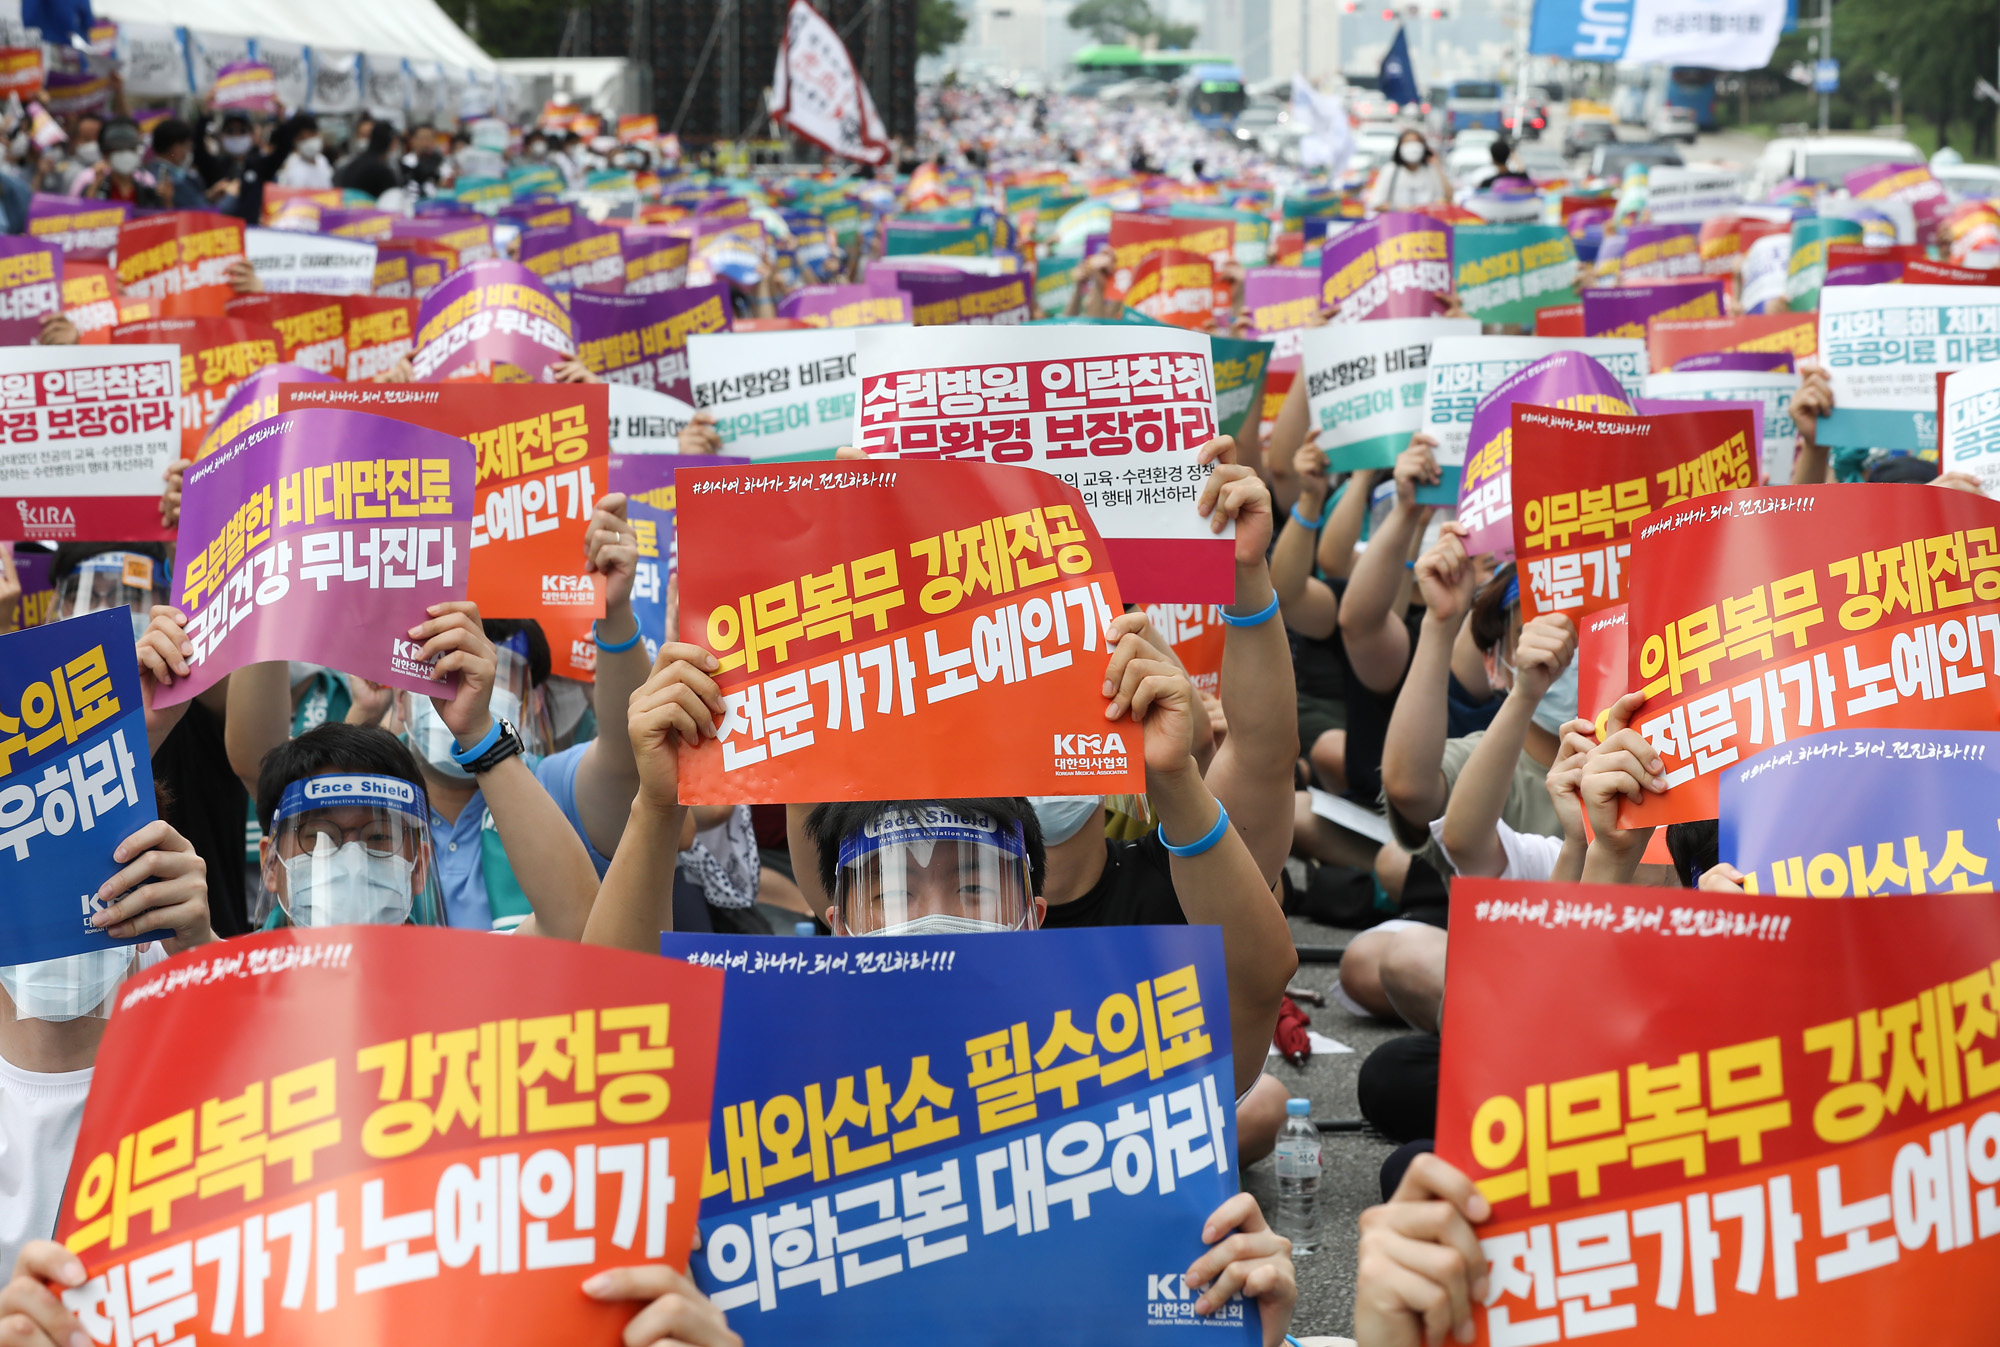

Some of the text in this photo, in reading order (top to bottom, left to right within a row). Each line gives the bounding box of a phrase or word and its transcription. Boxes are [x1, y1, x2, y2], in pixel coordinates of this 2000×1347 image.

[1385, 342, 1432, 373] 비급
[42, 362, 172, 404] 인력착취
[695, 366, 791, 409] 최신항암
[863, 365, 1030, 423] 수련병원
[1040, 356, 1212, 409] 인력착취
[47, 401, 175, 441] 보장하라
[1045, 407, 1216, 459] 보장하라
[692, 469, 897, 495] #의사여_하나가_되어_전진하라!!!
[1102, 489, 1132, 507] 행태
[1136, 485, 1197, 504] 개선하라
[181, 457, 453, 611] 무분별한 비대면진료
[1523, 476, 1652, 550] 의무복무
[1640, 496, 1815, 540] #의사여_하나가_되어_전진하라!!!
[299, 526, 457, 592] 무너진다
[541, 575, 595, 592] KMA
[705, 504, 1093, 676] 의무복무 강제전공
[1639, 525, 2000, 701] 의무복무 강제전공
[716, 581, 1115, 773] 전문가가 노예인가
[1054, 733, 1127, 755] KMA
[1640, 652, 1836, 793] 전문가가
[1054, 757, 1128, 770] 대한의사협회
[1740, 741, 1986, 783] #의사여_하나가_되어_전진하라!!!
[311, 781, 409, 799] Face Shield
[388, 801, 403, 809] Mask
[873, 811, 989, 833] Face Shield
[963, 832, 983, 840] Mask
[686, 950, 956, 974] #의사여_하나가_되어_전진하라!!!
[699, 964, 1213, 1203] 내외산소 필수의료
[66, 1003, 674, 1254] 의무복무 강제전공
[1470, 1035, 1792, 1208] 의무복무
[706, 1074, 1230, 1312] 의학근본 대우하라
[355, 1137, 675, 1294] 노예인가
[1482, 1174, 1803, 1347] 전문가가
